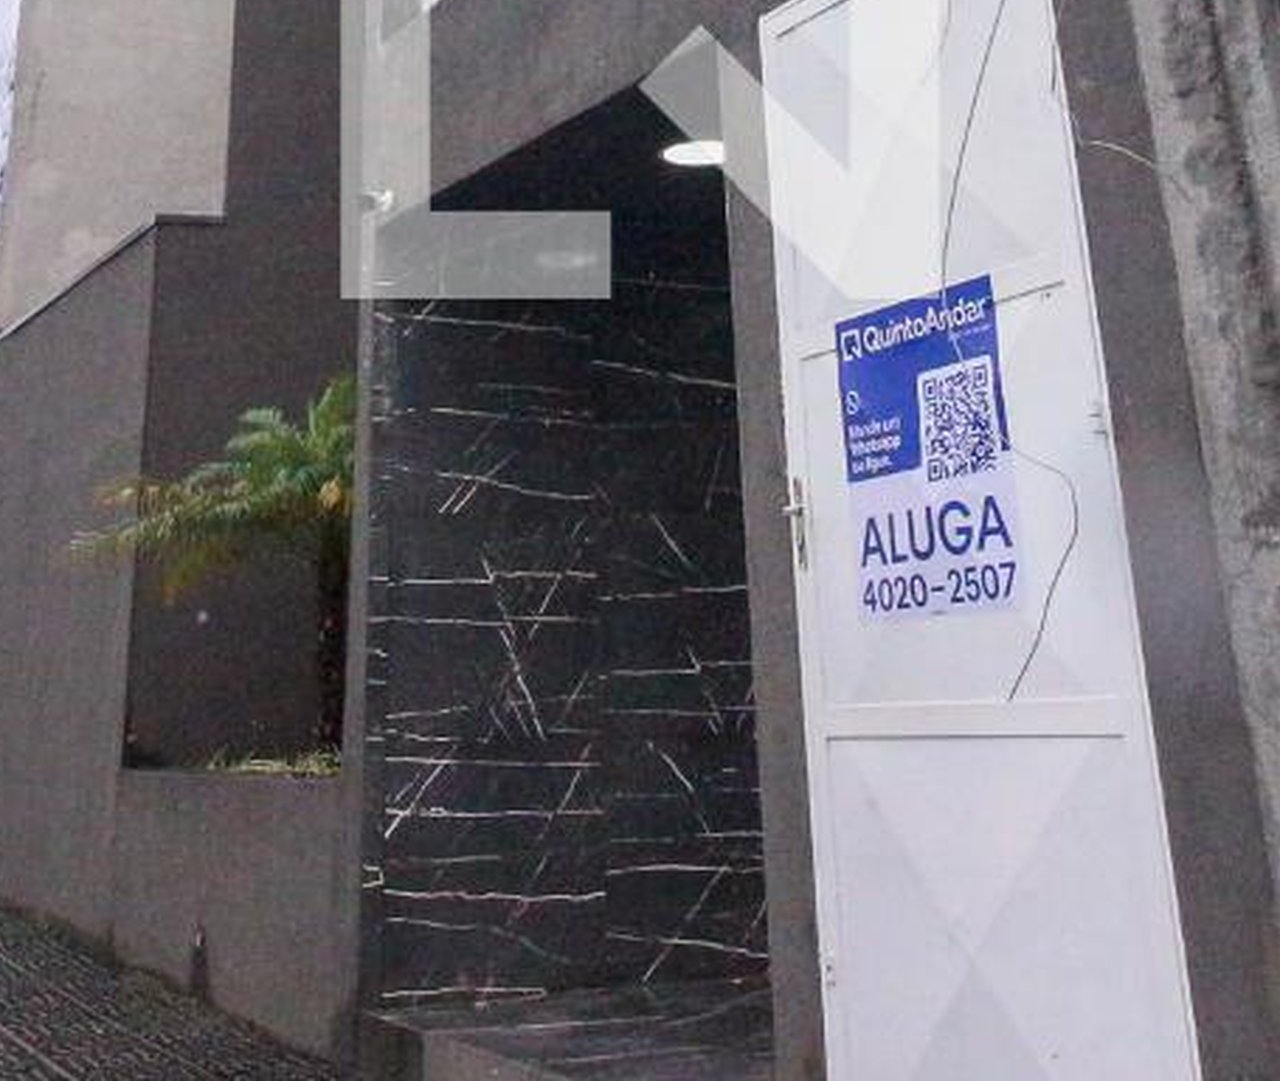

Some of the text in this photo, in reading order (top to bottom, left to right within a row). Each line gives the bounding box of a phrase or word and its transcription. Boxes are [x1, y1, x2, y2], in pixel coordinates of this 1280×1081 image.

[863, 298, 987, 353] QuintoAndar
[861, 495, 1013, 567] ALUGA
[862, 562, 1016, 613] 4020-2507
